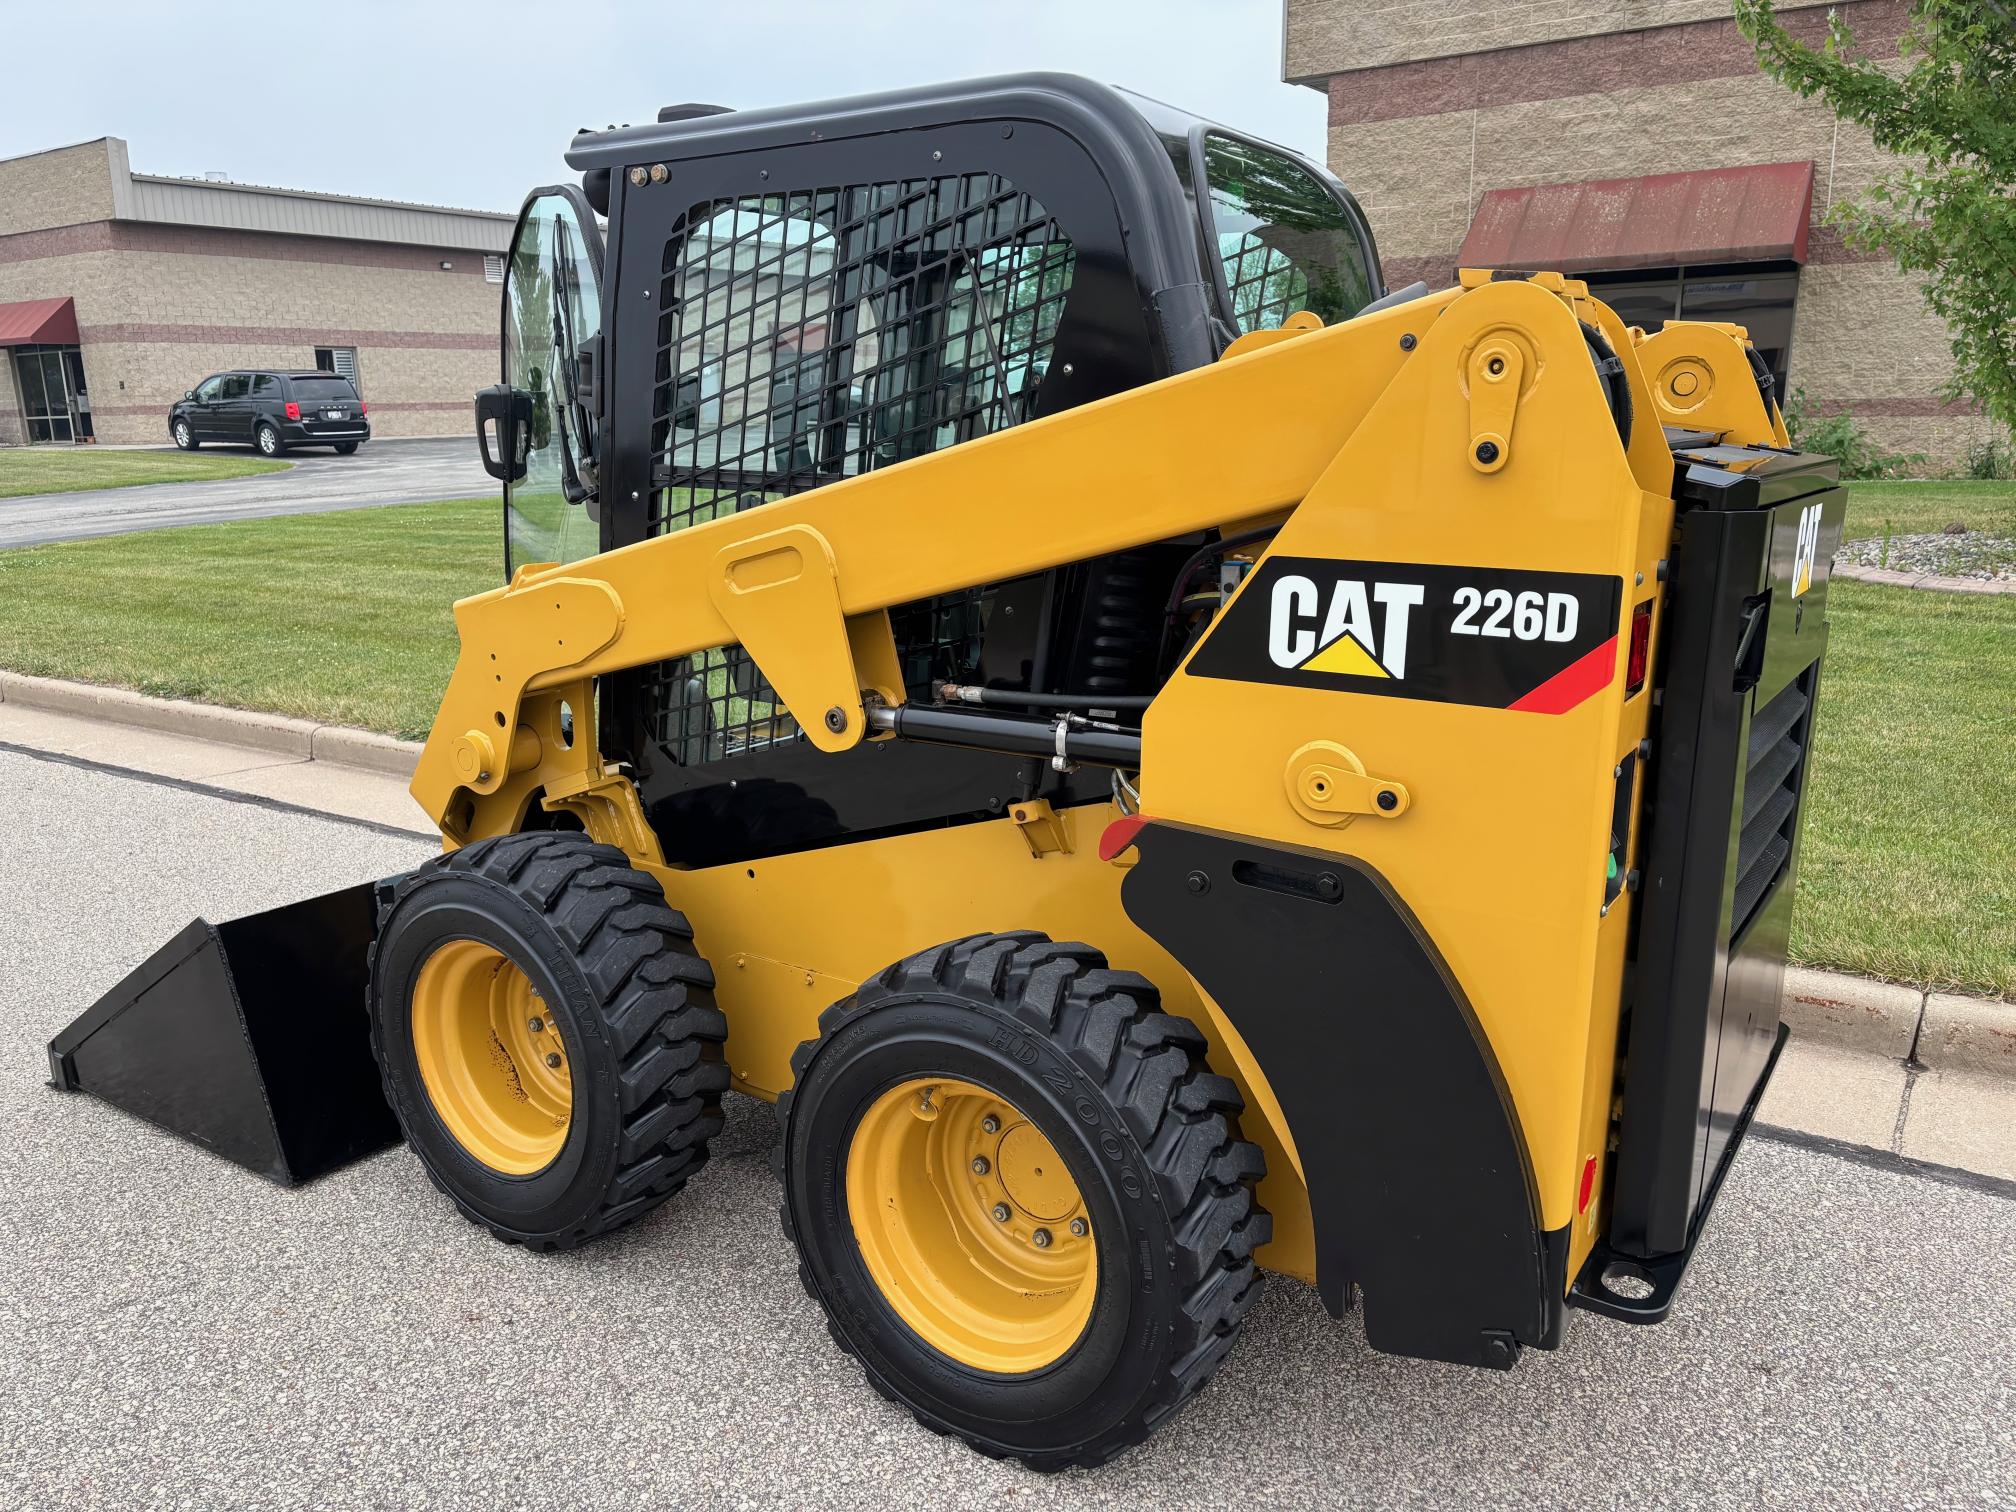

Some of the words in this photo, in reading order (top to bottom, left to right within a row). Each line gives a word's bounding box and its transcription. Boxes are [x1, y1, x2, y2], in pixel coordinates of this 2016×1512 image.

[1792, 502, 1823, 599] CAT
[1269, 575, 1425, 680] CAT
[1450, 586, 1580, 643] 226D
[547, 949, 602, 1039] TITAN
[987, 1026, 1040, 1066] HD
[1042, 1066, 1143, 1200] 2000
